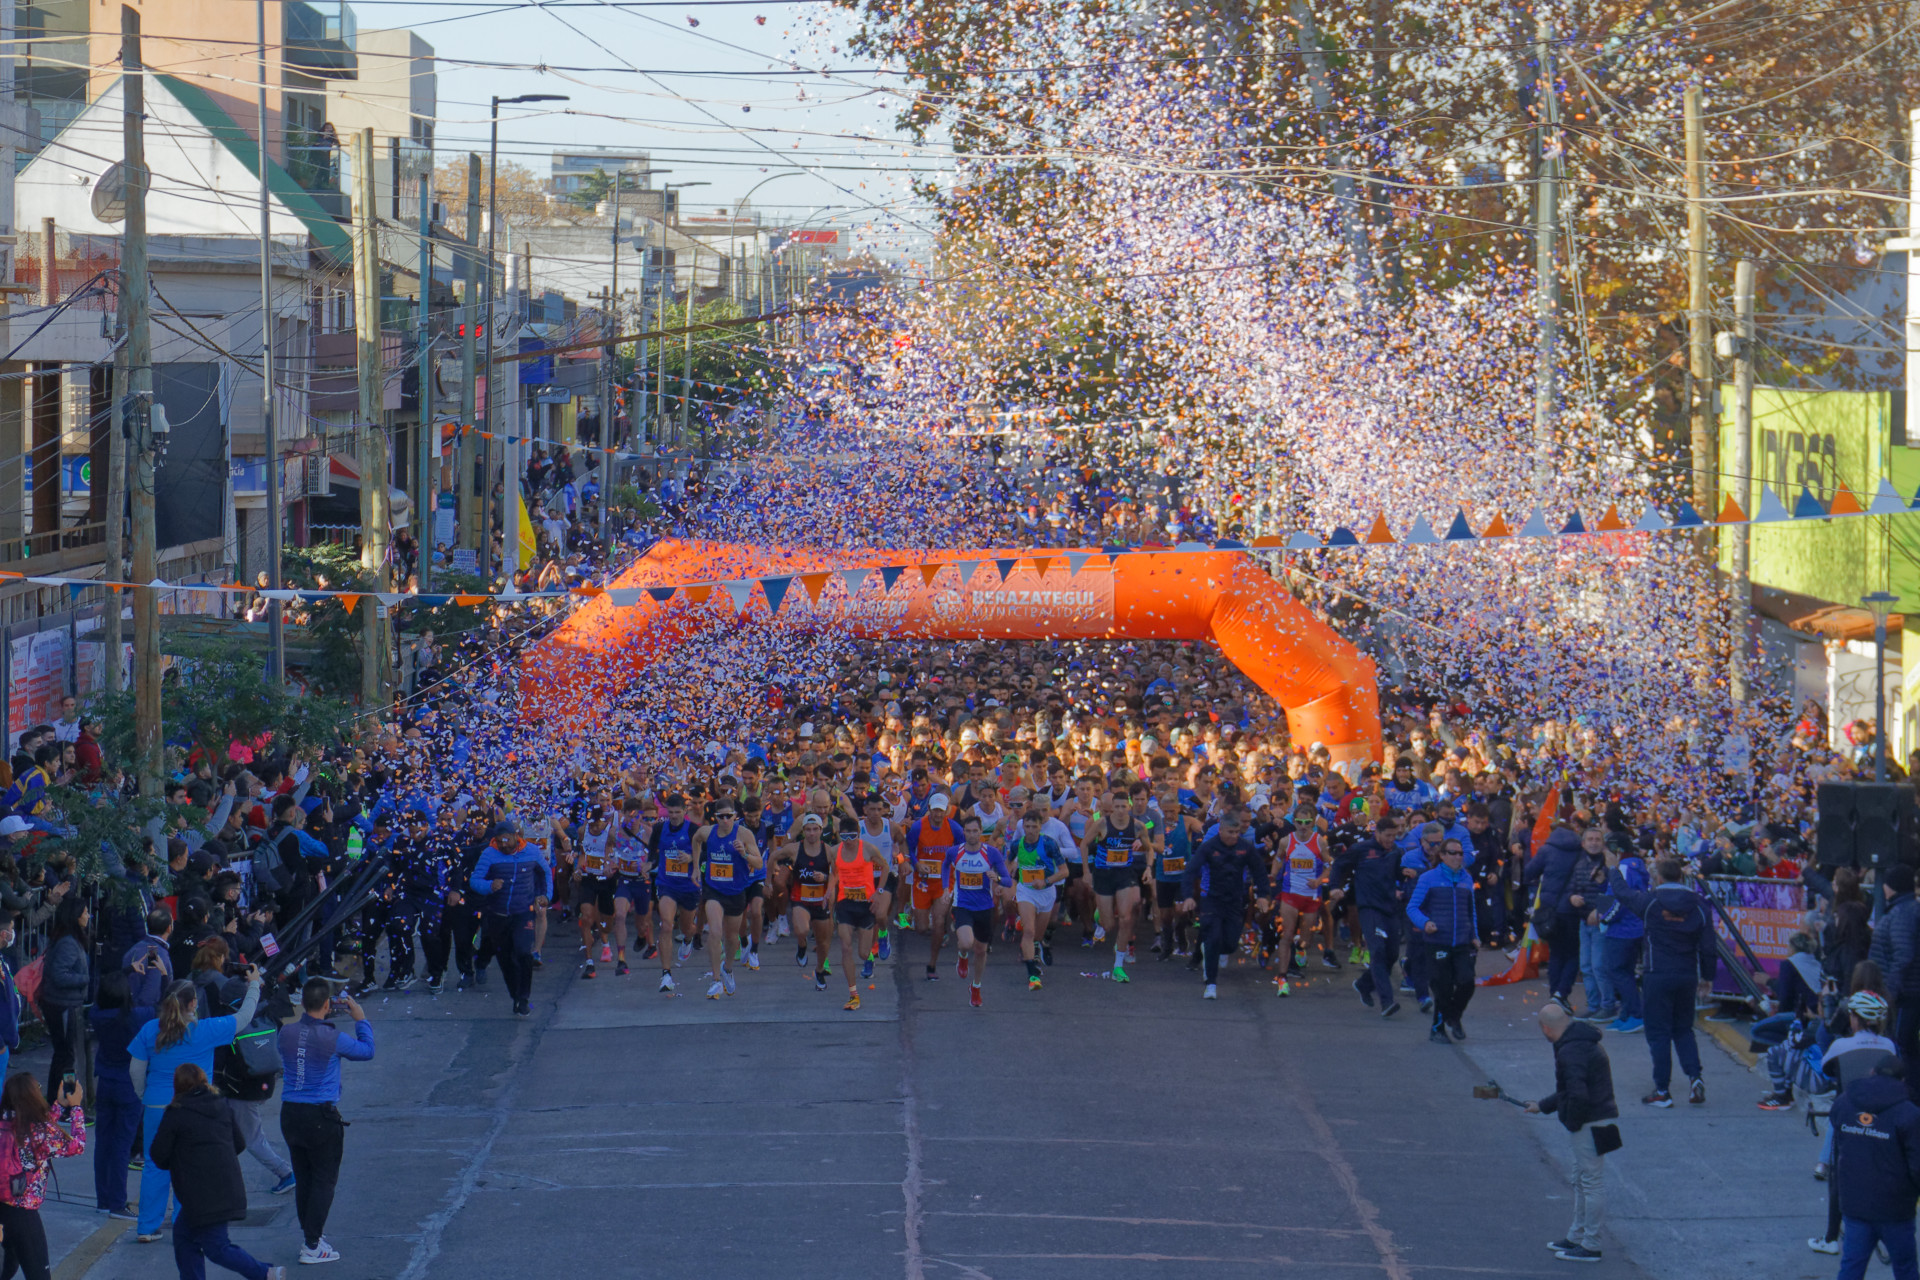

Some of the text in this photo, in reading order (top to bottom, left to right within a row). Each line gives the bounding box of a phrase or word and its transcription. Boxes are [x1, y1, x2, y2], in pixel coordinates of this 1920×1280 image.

[972, 590, 1095, 606] BERAZATEGUI
[972, 606, 1095, 618] MUNICIPALIDAD
[671, 864, 682, 873] 63
[962, 860, 983, 868] FILA
[716, 869, 726, 877] 61
[960, 878, 982, 886] 1168
[1758, 925, 1776, 944] DEL
[297, 1047, 306, 1058] DE
[1841, 1123, 1865, 1135] Control
